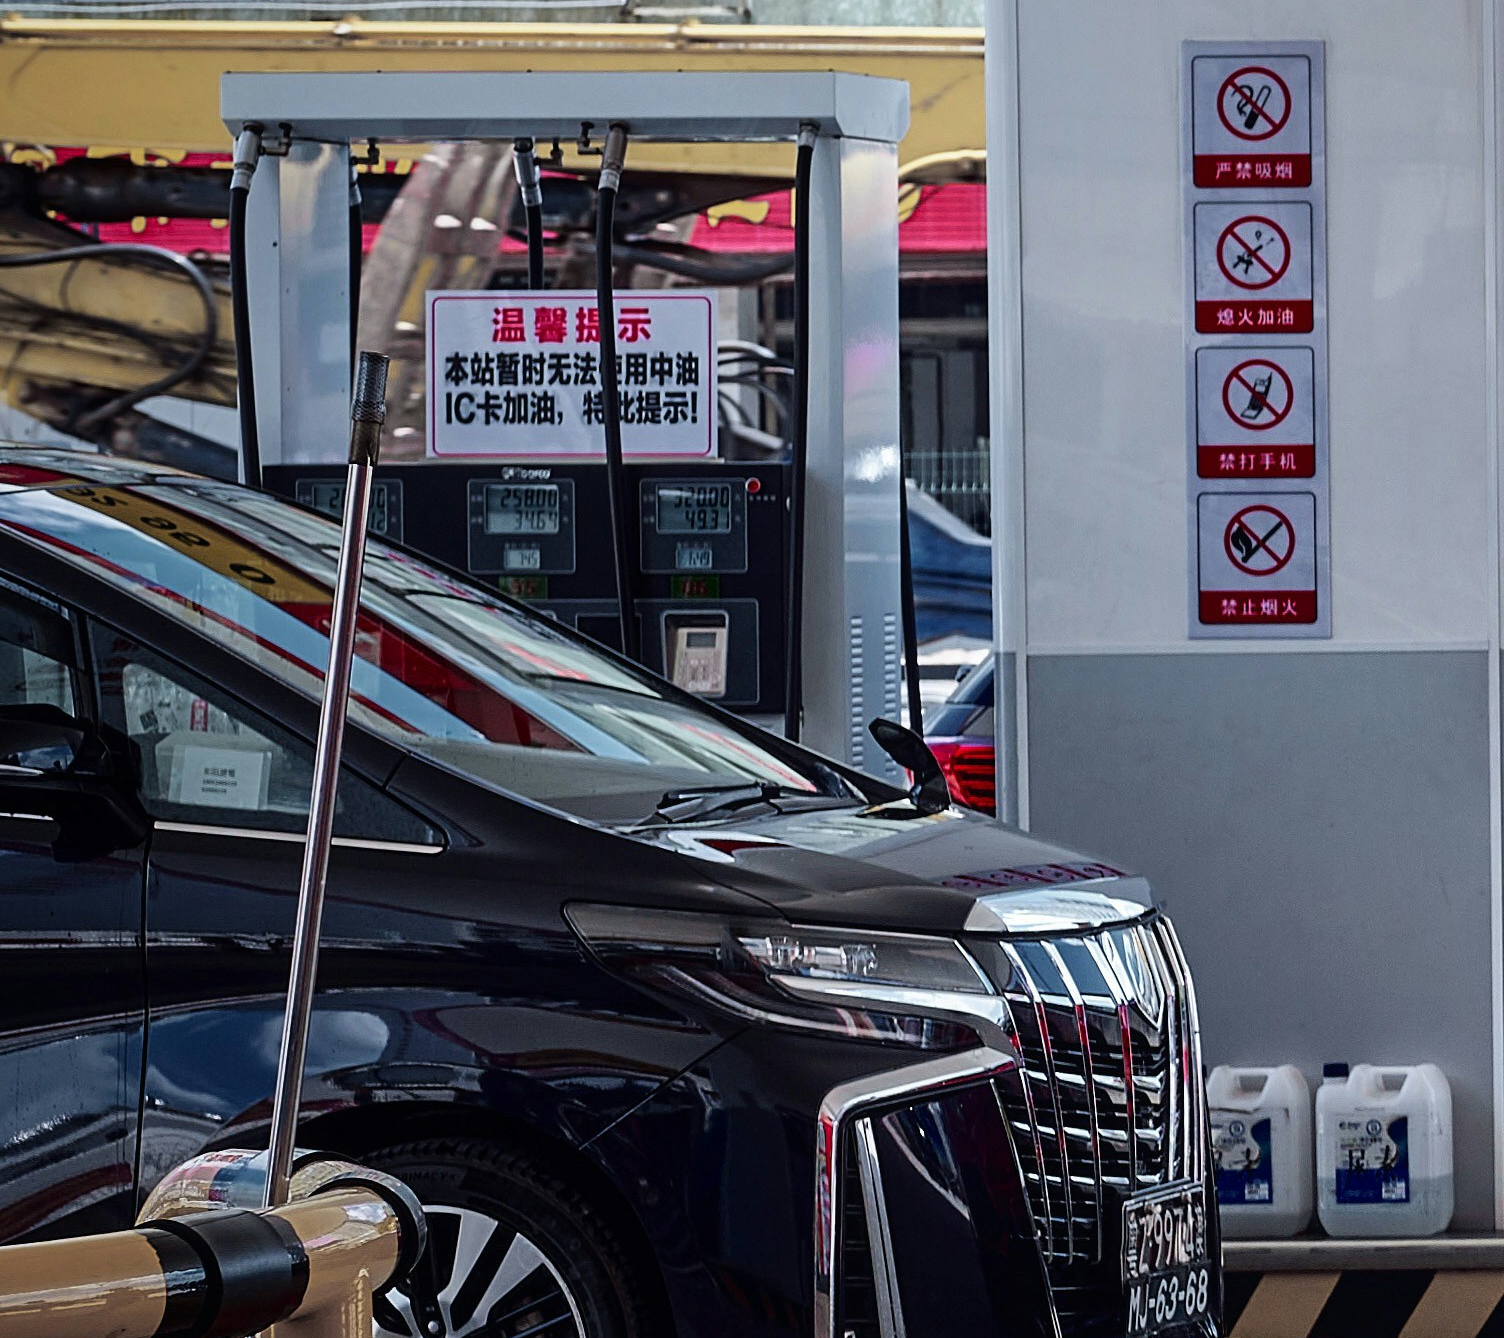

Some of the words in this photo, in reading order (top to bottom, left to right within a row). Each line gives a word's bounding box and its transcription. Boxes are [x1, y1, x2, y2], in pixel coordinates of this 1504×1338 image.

[1216, 162, 1293, 181] 严禁吸烟
[492, 306, 652, 343] 温馨提示
[1217, 307, 1294, 326] 熄火加油
[1219, 452, 1297, 471] 禁打手机
[1221, 597, 1298, 617] 禁止烟火
[1128, 1268, 1208, 1333] MJ-63-68
